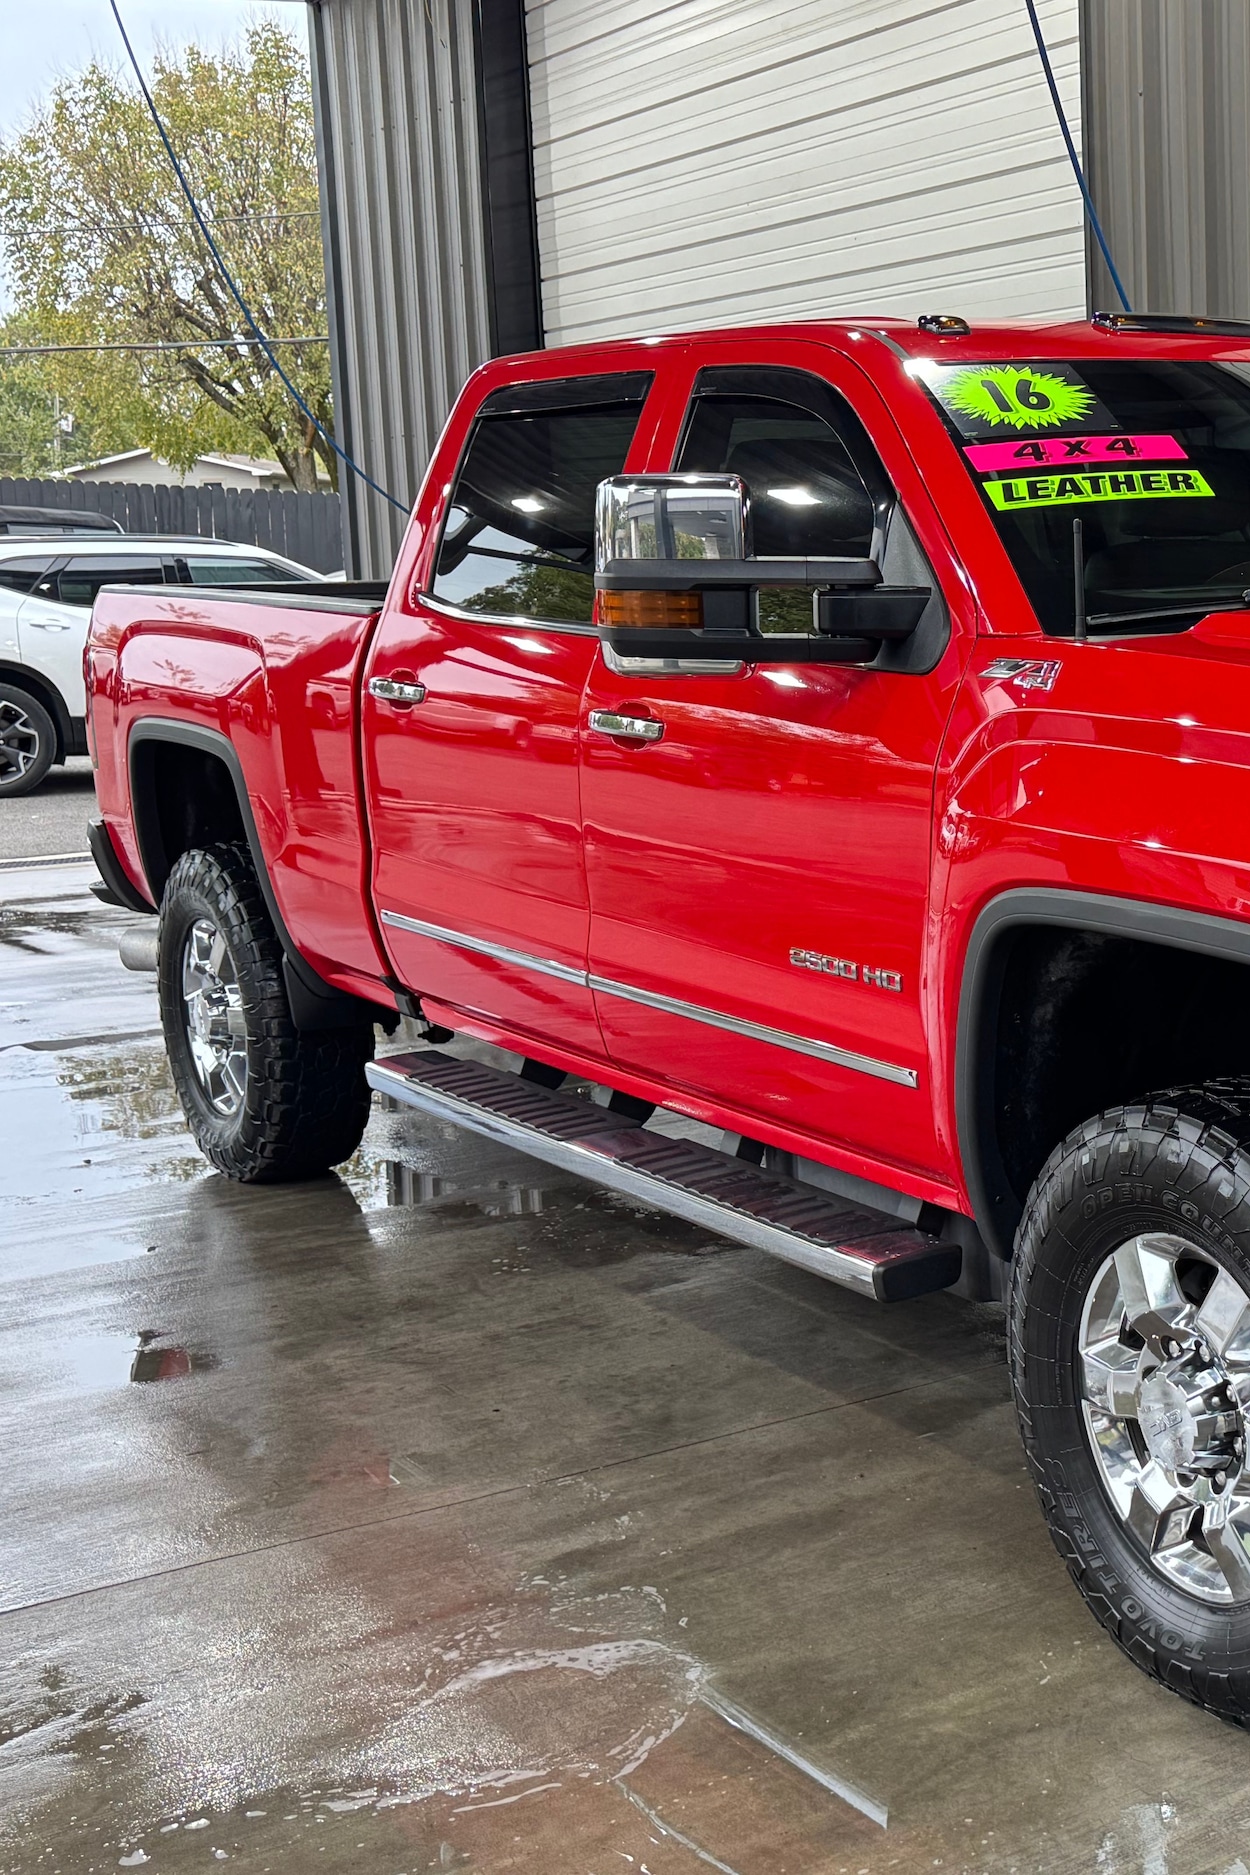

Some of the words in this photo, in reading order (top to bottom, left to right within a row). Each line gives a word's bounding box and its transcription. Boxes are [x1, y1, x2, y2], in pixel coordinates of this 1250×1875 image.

[981, 378, 1052, 412] 16
[1013, 441, 1049, 462] 4
[1105, 437, 1139, 456] 4
[1001, 472, 1198, 503] LEATHER
[789, 946, 859, 982] 2500
[862, 964, 905, 993] HD
[1080, 1183, 1153, 1220] OPEN
[1044, 1457, 1122, 1596] TIRES
[1120, 1594, 1207, 1661] TOYO
